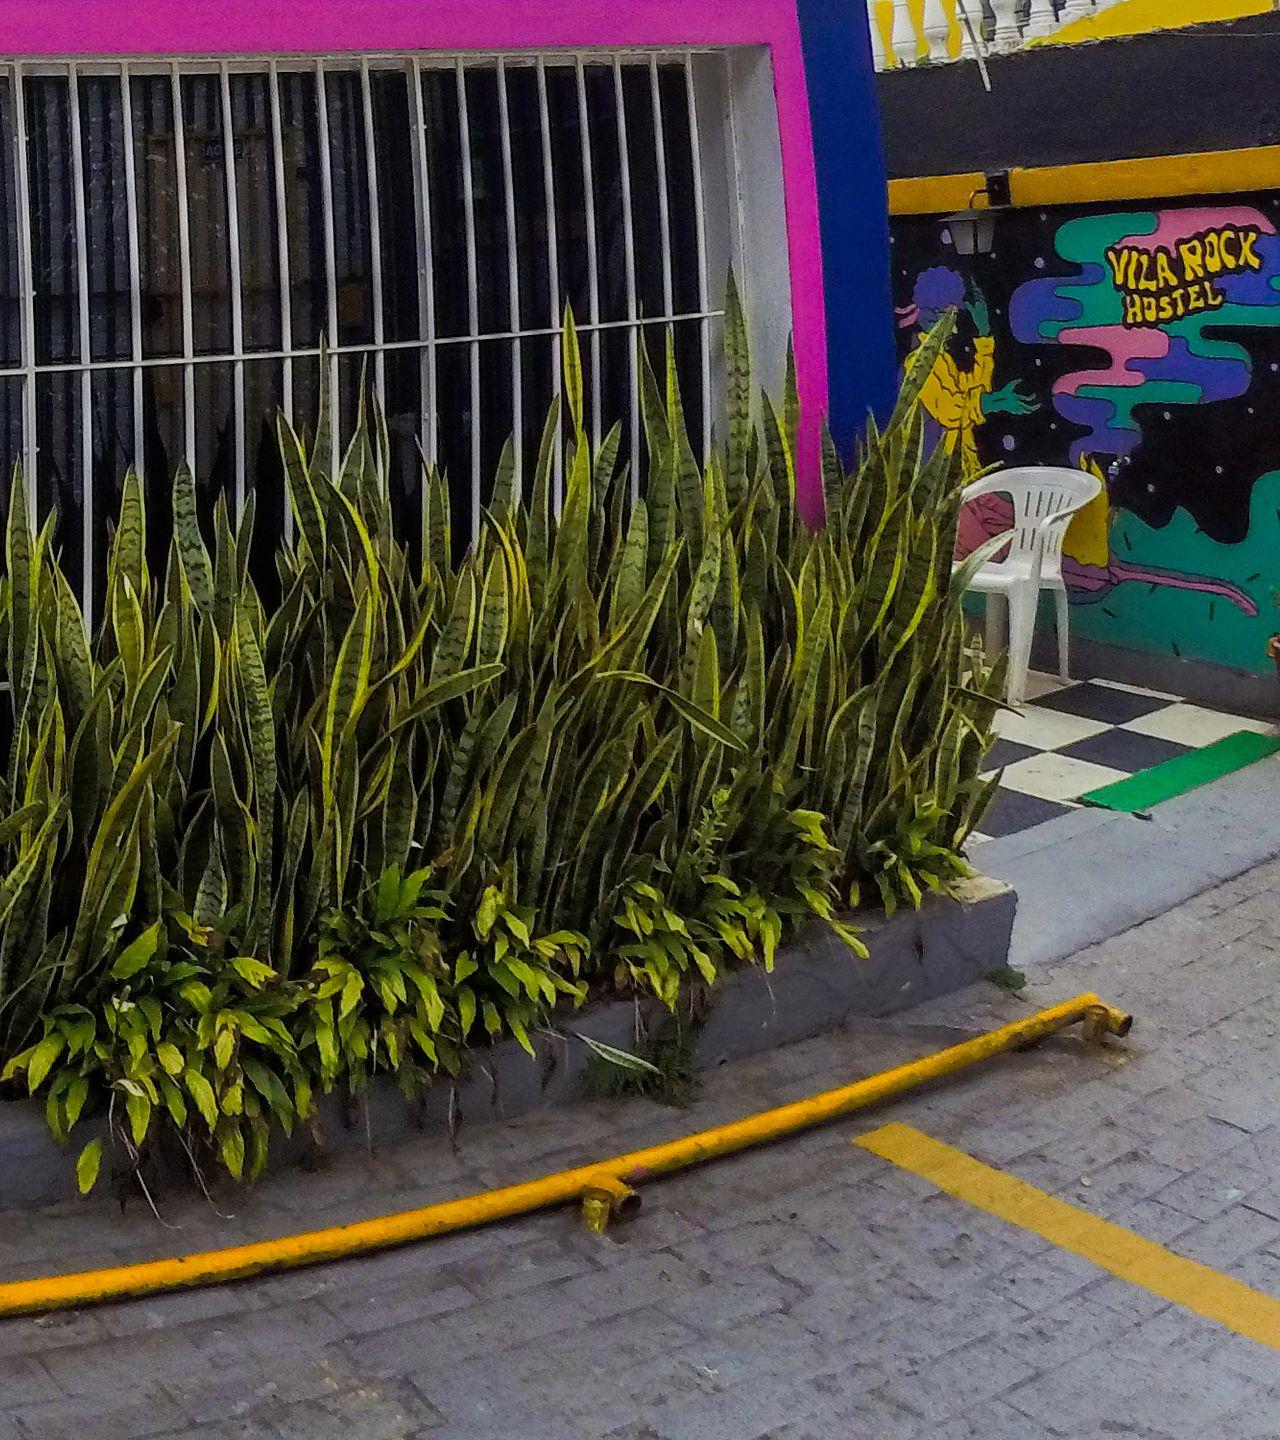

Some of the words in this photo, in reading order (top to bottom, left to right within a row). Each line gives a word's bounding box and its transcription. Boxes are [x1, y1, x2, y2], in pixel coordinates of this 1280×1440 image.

[1107, 248, 1179, 292] VILA
[1179, 229, 1261, 281] ROCK
[1125, 281, 1223, 324] HOSTEL
